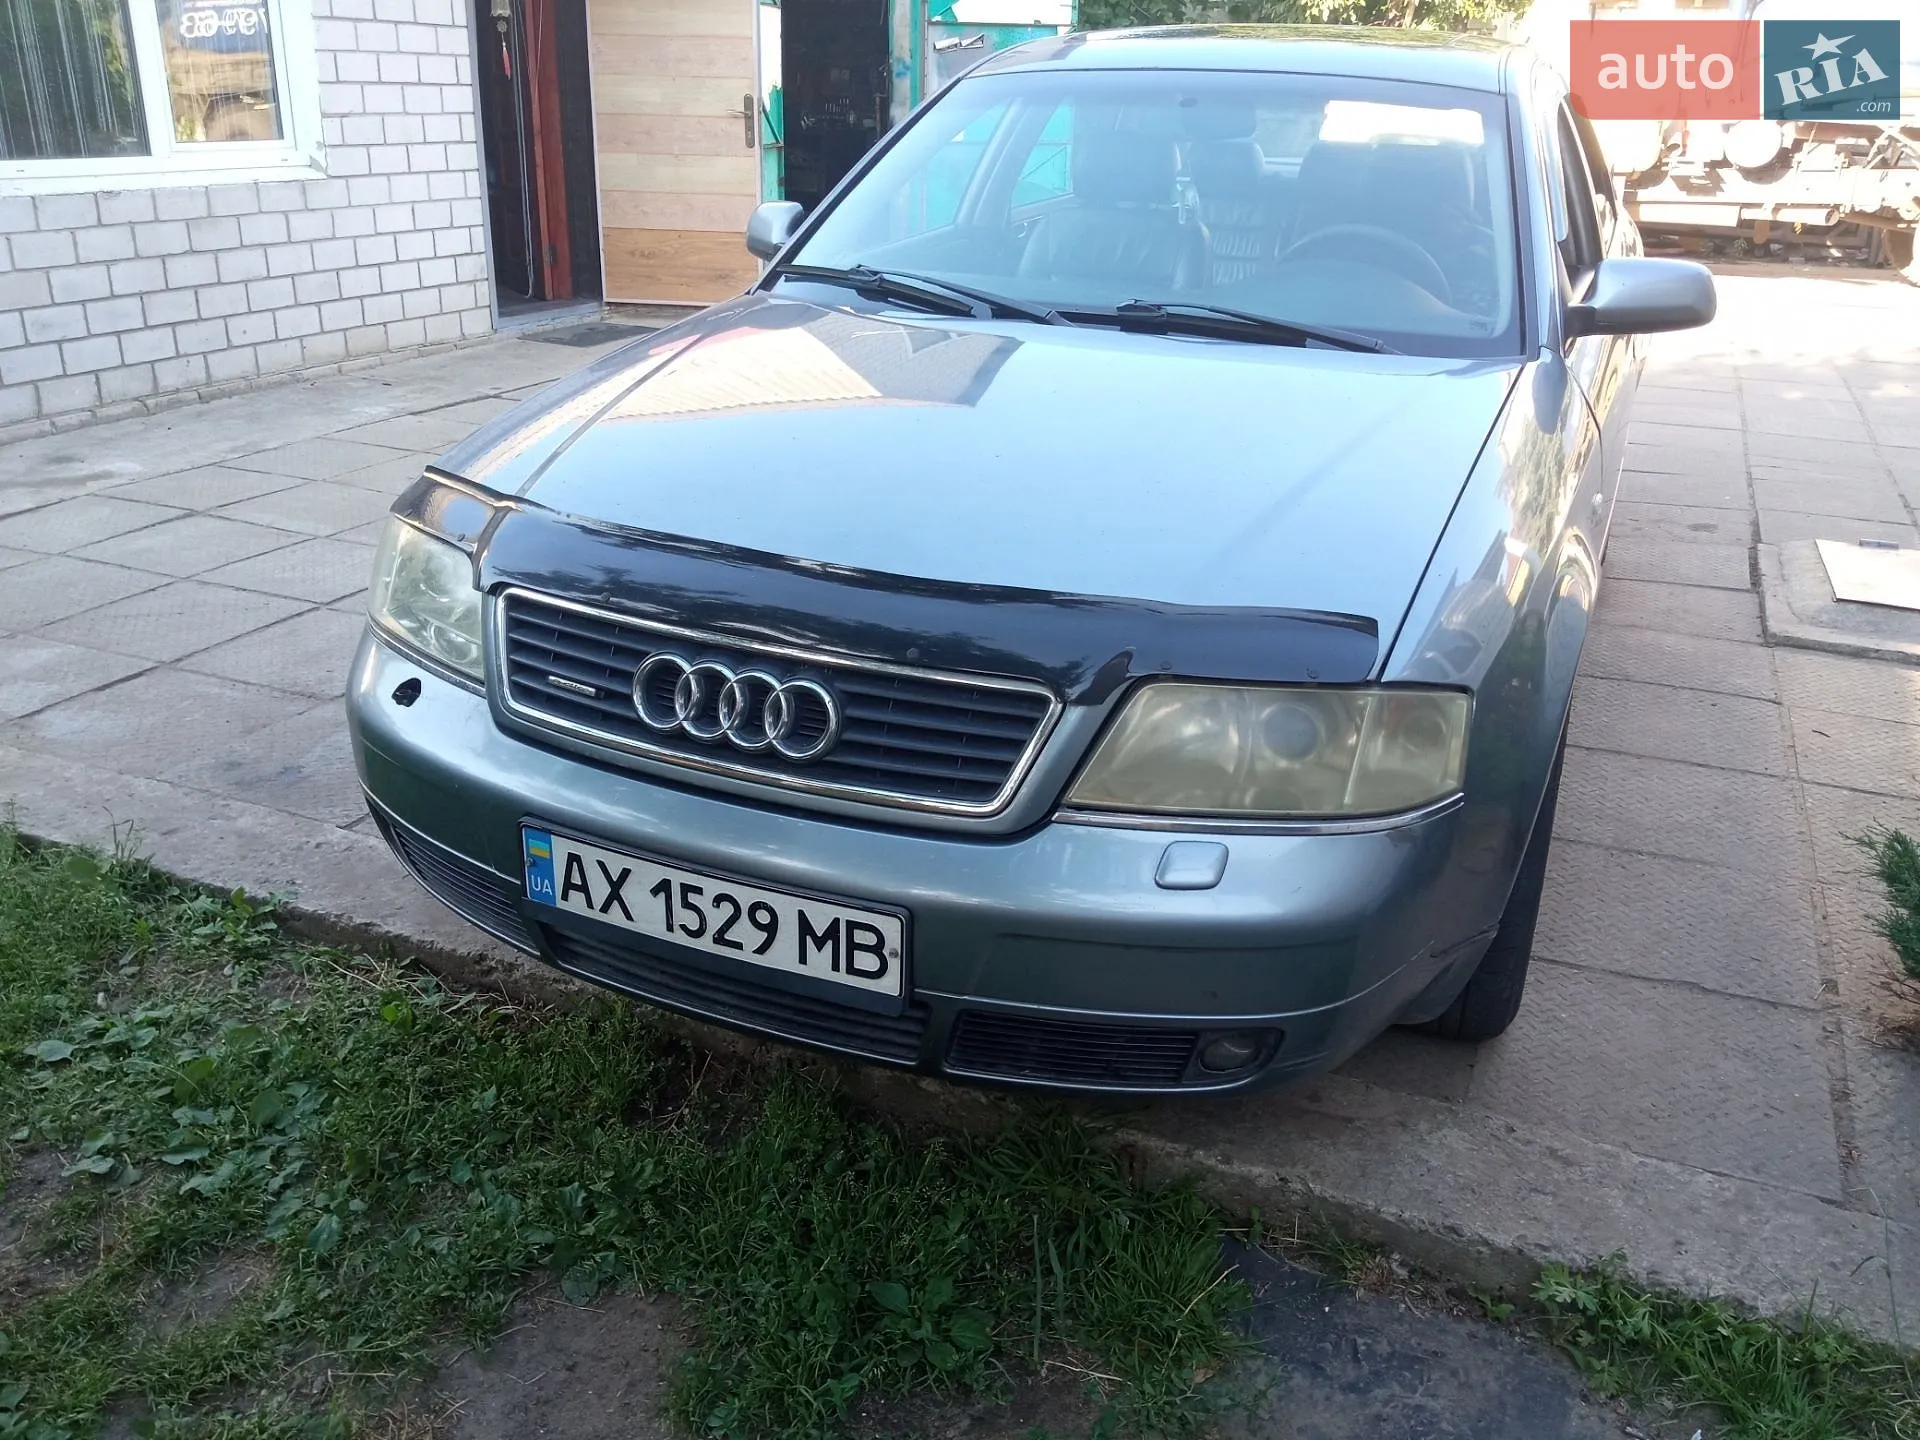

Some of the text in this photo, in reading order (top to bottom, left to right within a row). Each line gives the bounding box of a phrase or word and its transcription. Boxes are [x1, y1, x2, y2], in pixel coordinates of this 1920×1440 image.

[531, 874, 553, 897] UA
[560, 851, 889, 980] AX 1529 MB
